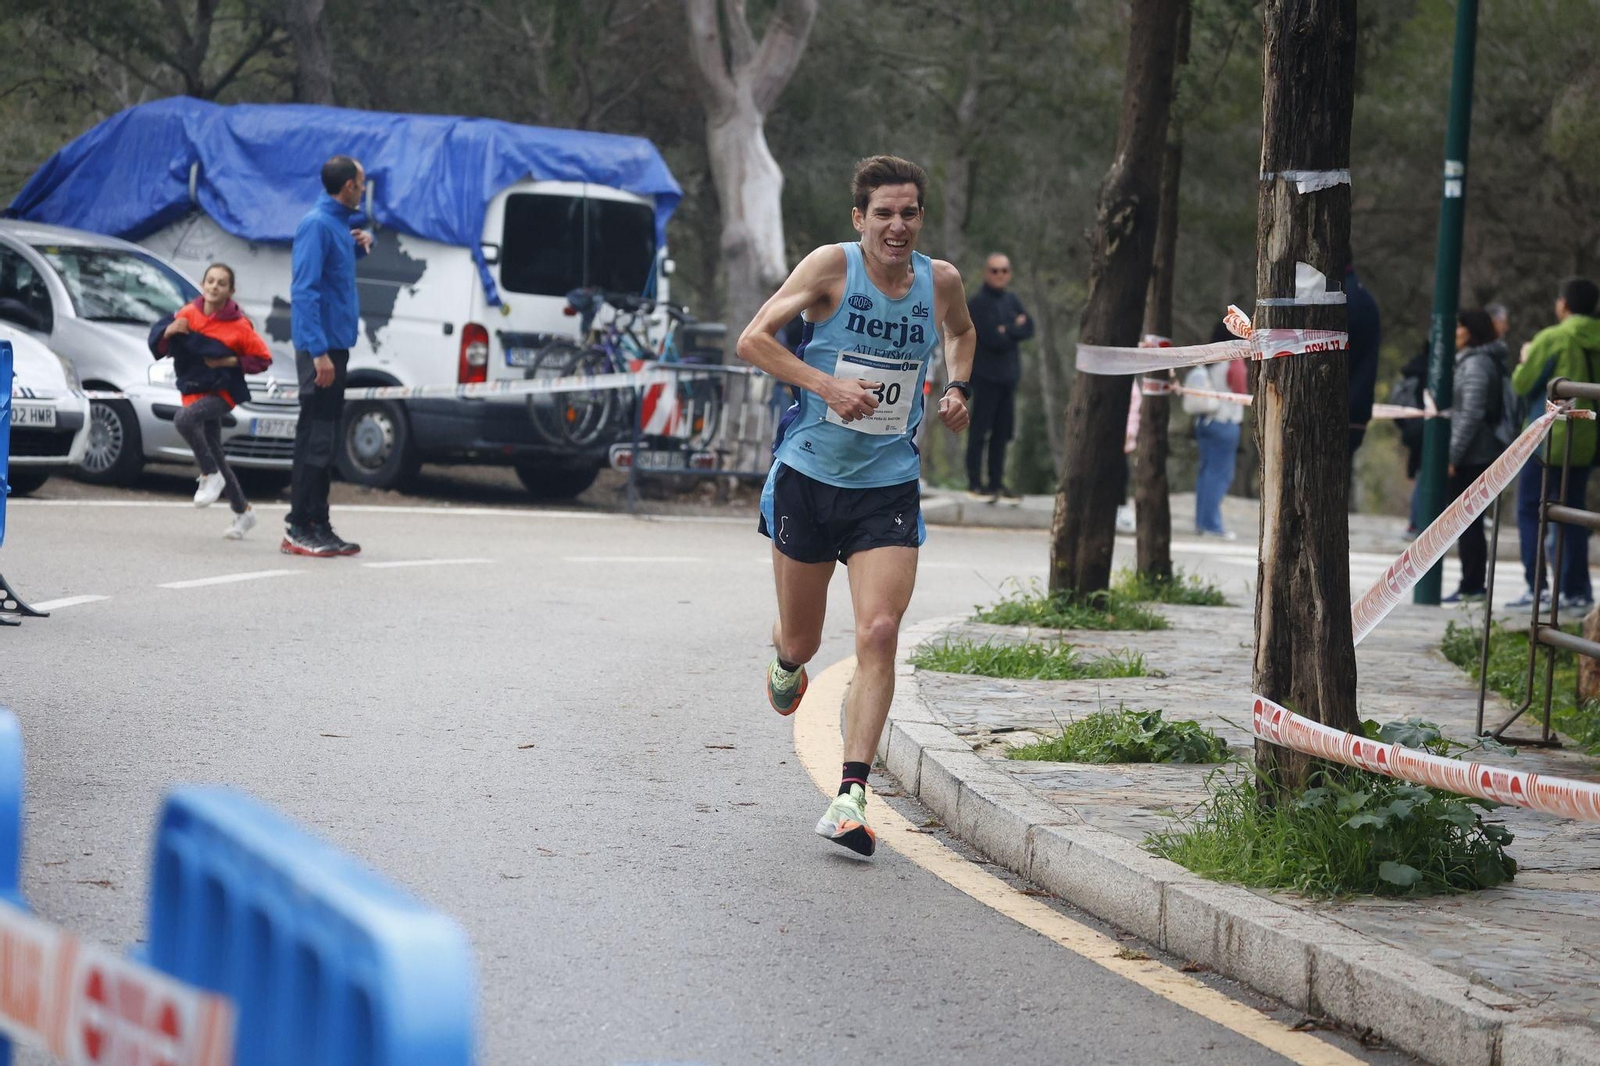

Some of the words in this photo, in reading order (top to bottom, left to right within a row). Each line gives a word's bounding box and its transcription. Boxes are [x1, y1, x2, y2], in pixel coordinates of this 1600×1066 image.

[845, 311, 925, 348] nerja
[853, 343, 912, 360] ATLETISMO
[859, 378, 900, 405] 30
